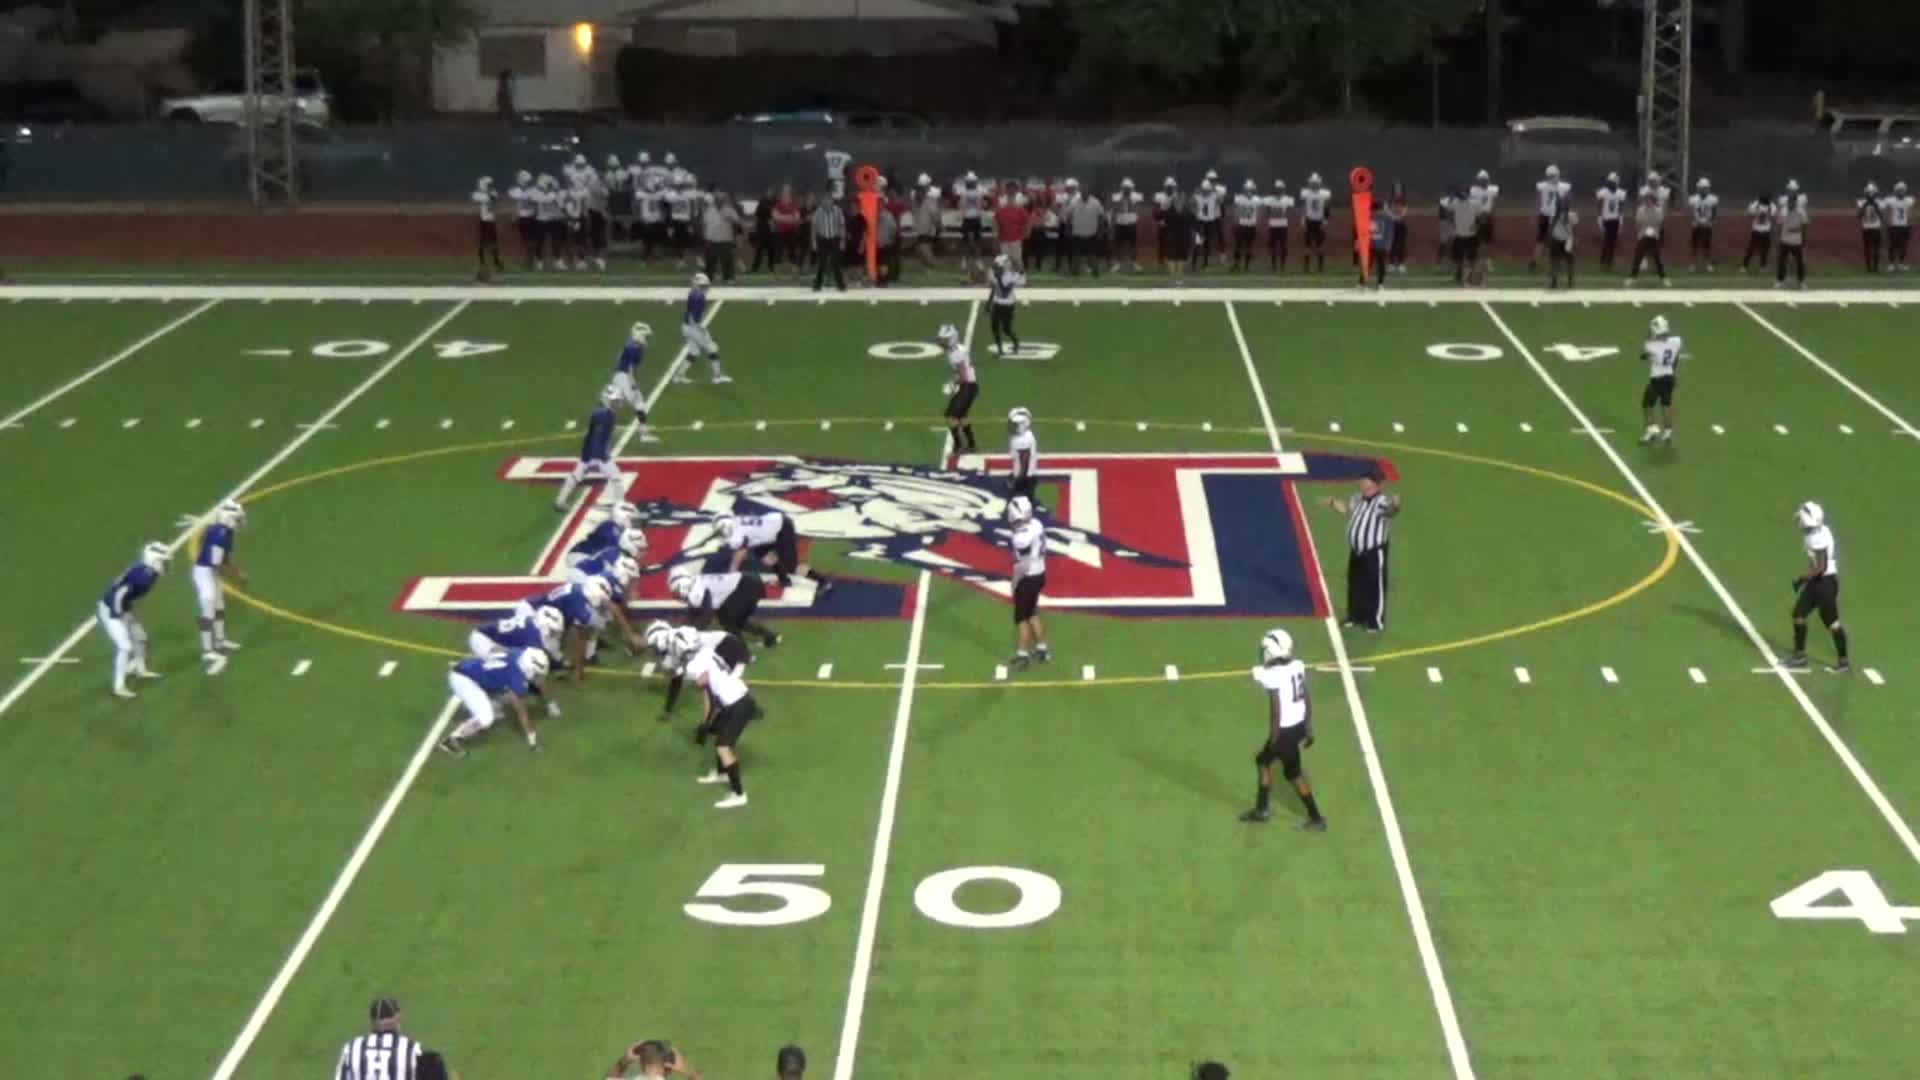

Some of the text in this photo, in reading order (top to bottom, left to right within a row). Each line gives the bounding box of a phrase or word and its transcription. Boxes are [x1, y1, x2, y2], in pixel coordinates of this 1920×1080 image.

[1662, 349, 1673, 366] 2
[1291, 672, 1305, 703] 12
[364, 1048, 392, 1080] H
